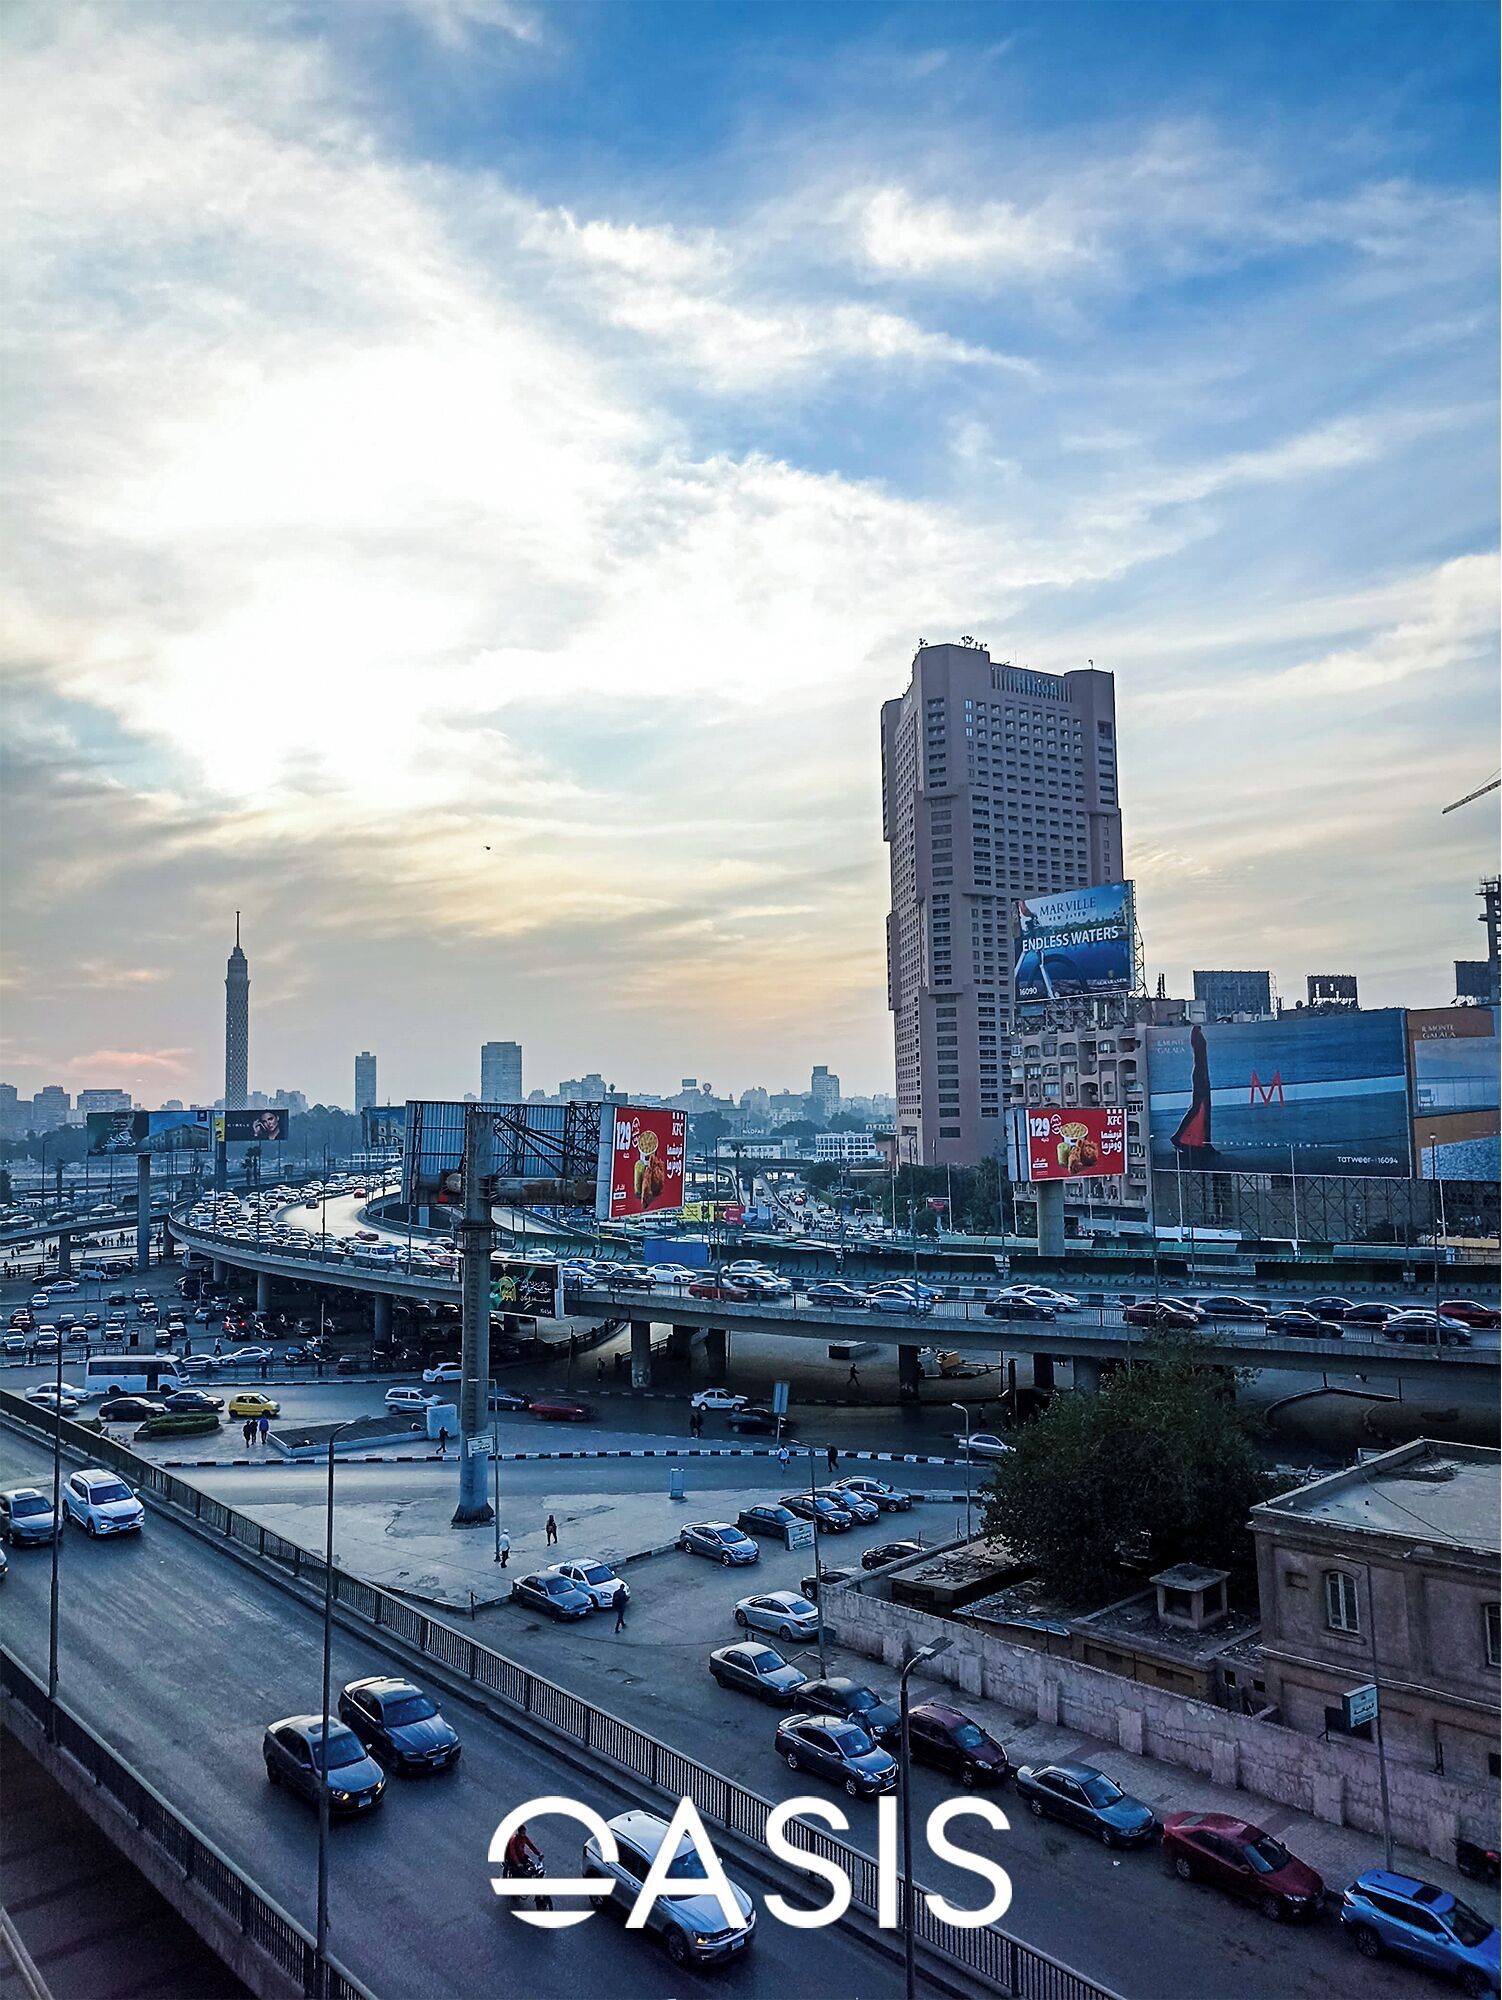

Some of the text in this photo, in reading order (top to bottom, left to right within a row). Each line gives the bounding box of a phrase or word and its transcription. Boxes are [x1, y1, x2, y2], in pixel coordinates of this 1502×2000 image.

[1016, 673, 1057, 696] Hilton
[1039, 897, 1096, 917] MARVILLE
[1022, 926, 1119, 953] ENDLESS WATERS
[1019, 986, 1037, 996] 16090
[1250, 1071, 1284, 1109] M
[672, 1122, 684, 1136] KFC
[1029, 1118, 1050, 1137] 129
[1107, 1115, 1122, 1126] KFC
[616, 1122, 631, 1151] 129
